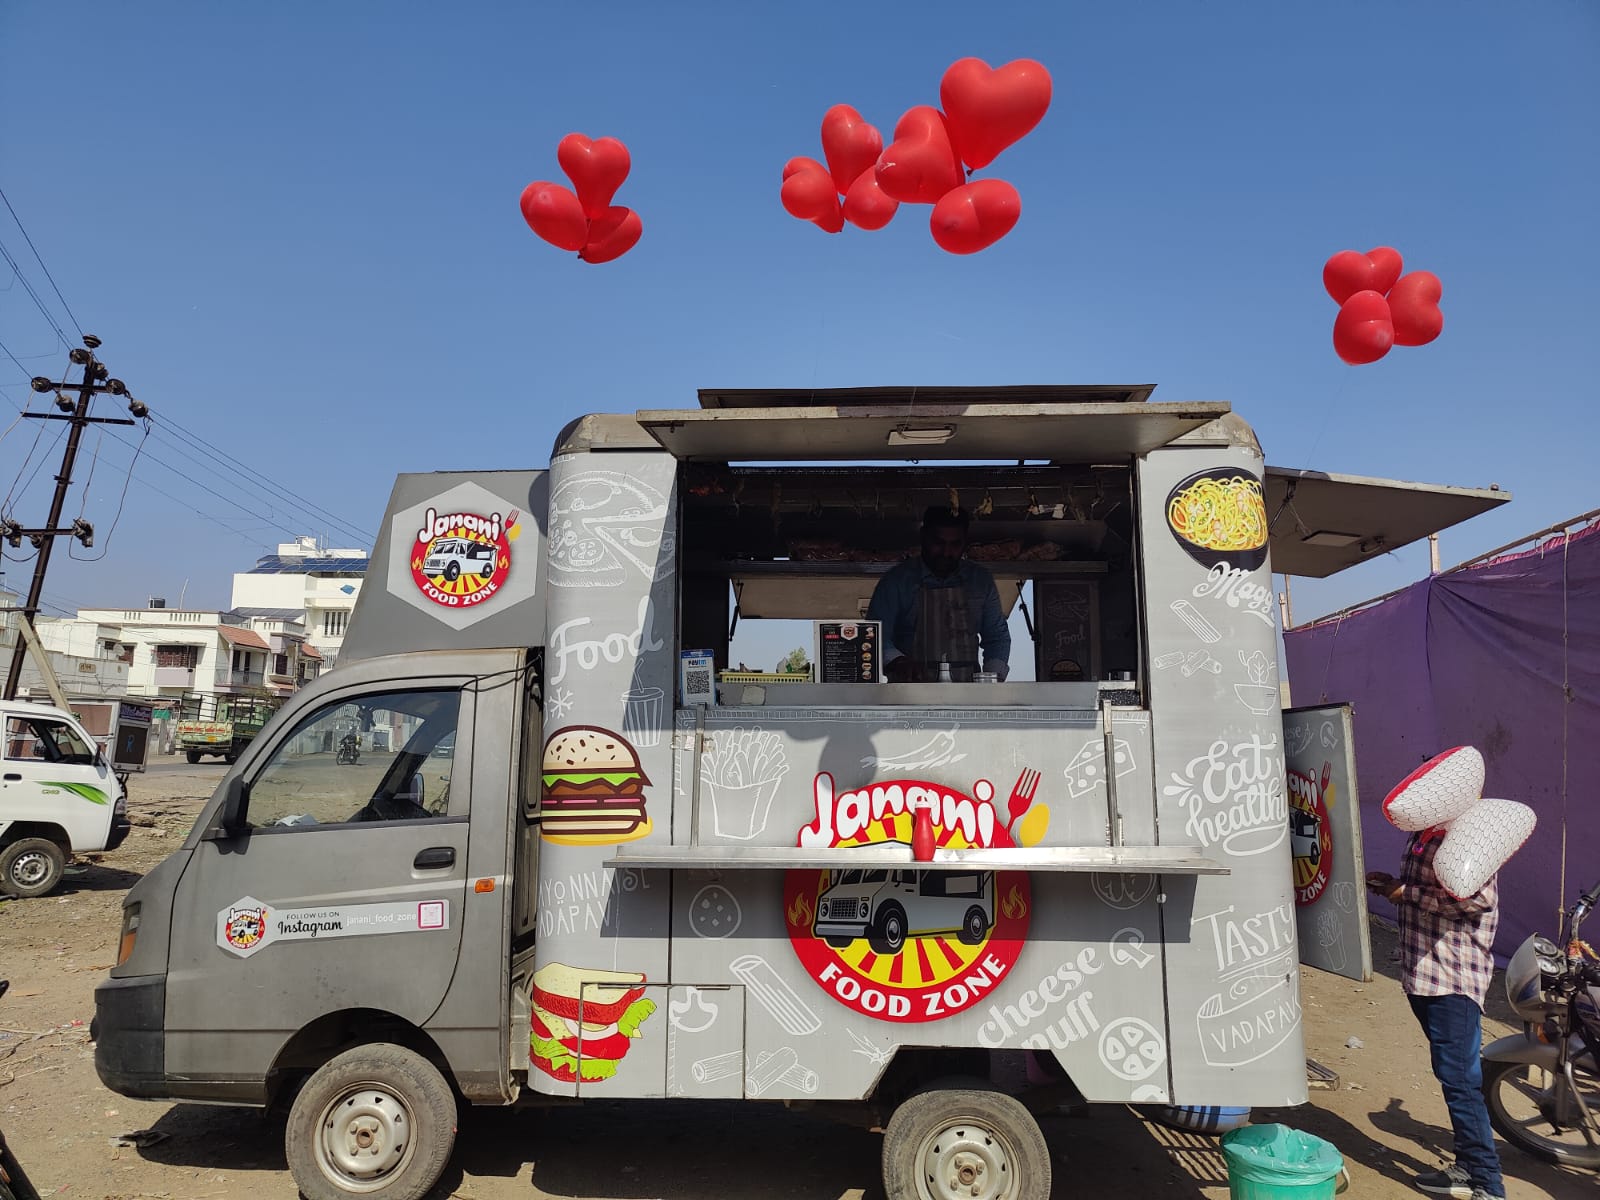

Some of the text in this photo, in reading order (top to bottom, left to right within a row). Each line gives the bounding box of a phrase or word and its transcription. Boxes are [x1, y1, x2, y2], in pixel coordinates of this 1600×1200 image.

[418, 508, 500, 543] Janani
[422, 582, 498, 605] FOOD ZONE
[1192, 561, 1274, 613] Magg
[550, 595, 664, 686] Food
[1185, 734, 1277, 804] Eat
[800, 771, 995, 848] Janani
[1300, 869, 1327, 903] ZONE
[228, 908, 261, 923] Janani
[277, 918, 343, 938] Instagram
[286, 912, 316, 921] FOLLOW
[346, 912, 417, 927] janani_food_zone
[1192, 902, 1295, 972] TASTY
[818, 952, 1006, 1017] FOOD ZONE
[977, 947, 1105, 1049] cheese
